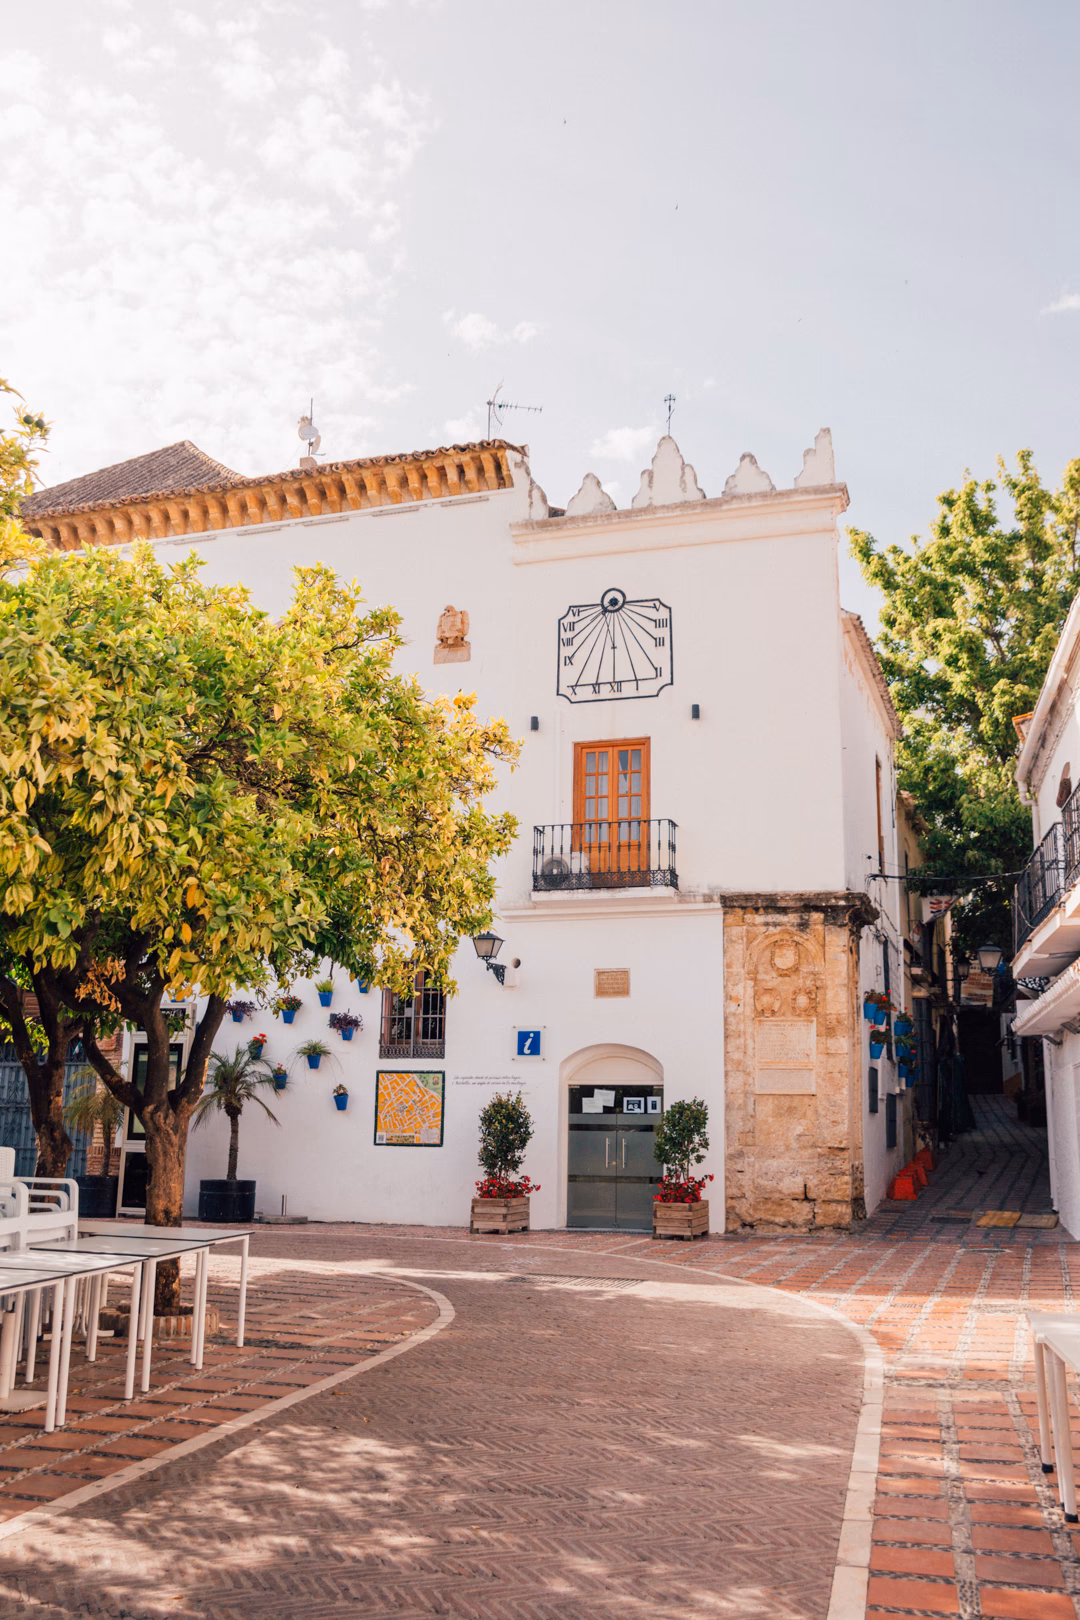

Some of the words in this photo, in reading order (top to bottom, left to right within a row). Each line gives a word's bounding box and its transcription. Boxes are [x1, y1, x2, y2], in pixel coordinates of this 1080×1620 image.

[571, 609, 581, 617] VI
[562, 622, 575, 632] VII
[654, 618, 668, 628] IIII
[562, 638, 574, 647] VIII
[655, 637, 665, 647] III
[564, 655, 575, 666] IX
[655, 667, 662, 678] II
[570, 685, 577, 696] X
[591, 683, 600, 694] XI
[609, 681, 622, 693] XII
[524, 1033, 534, 1054] i
